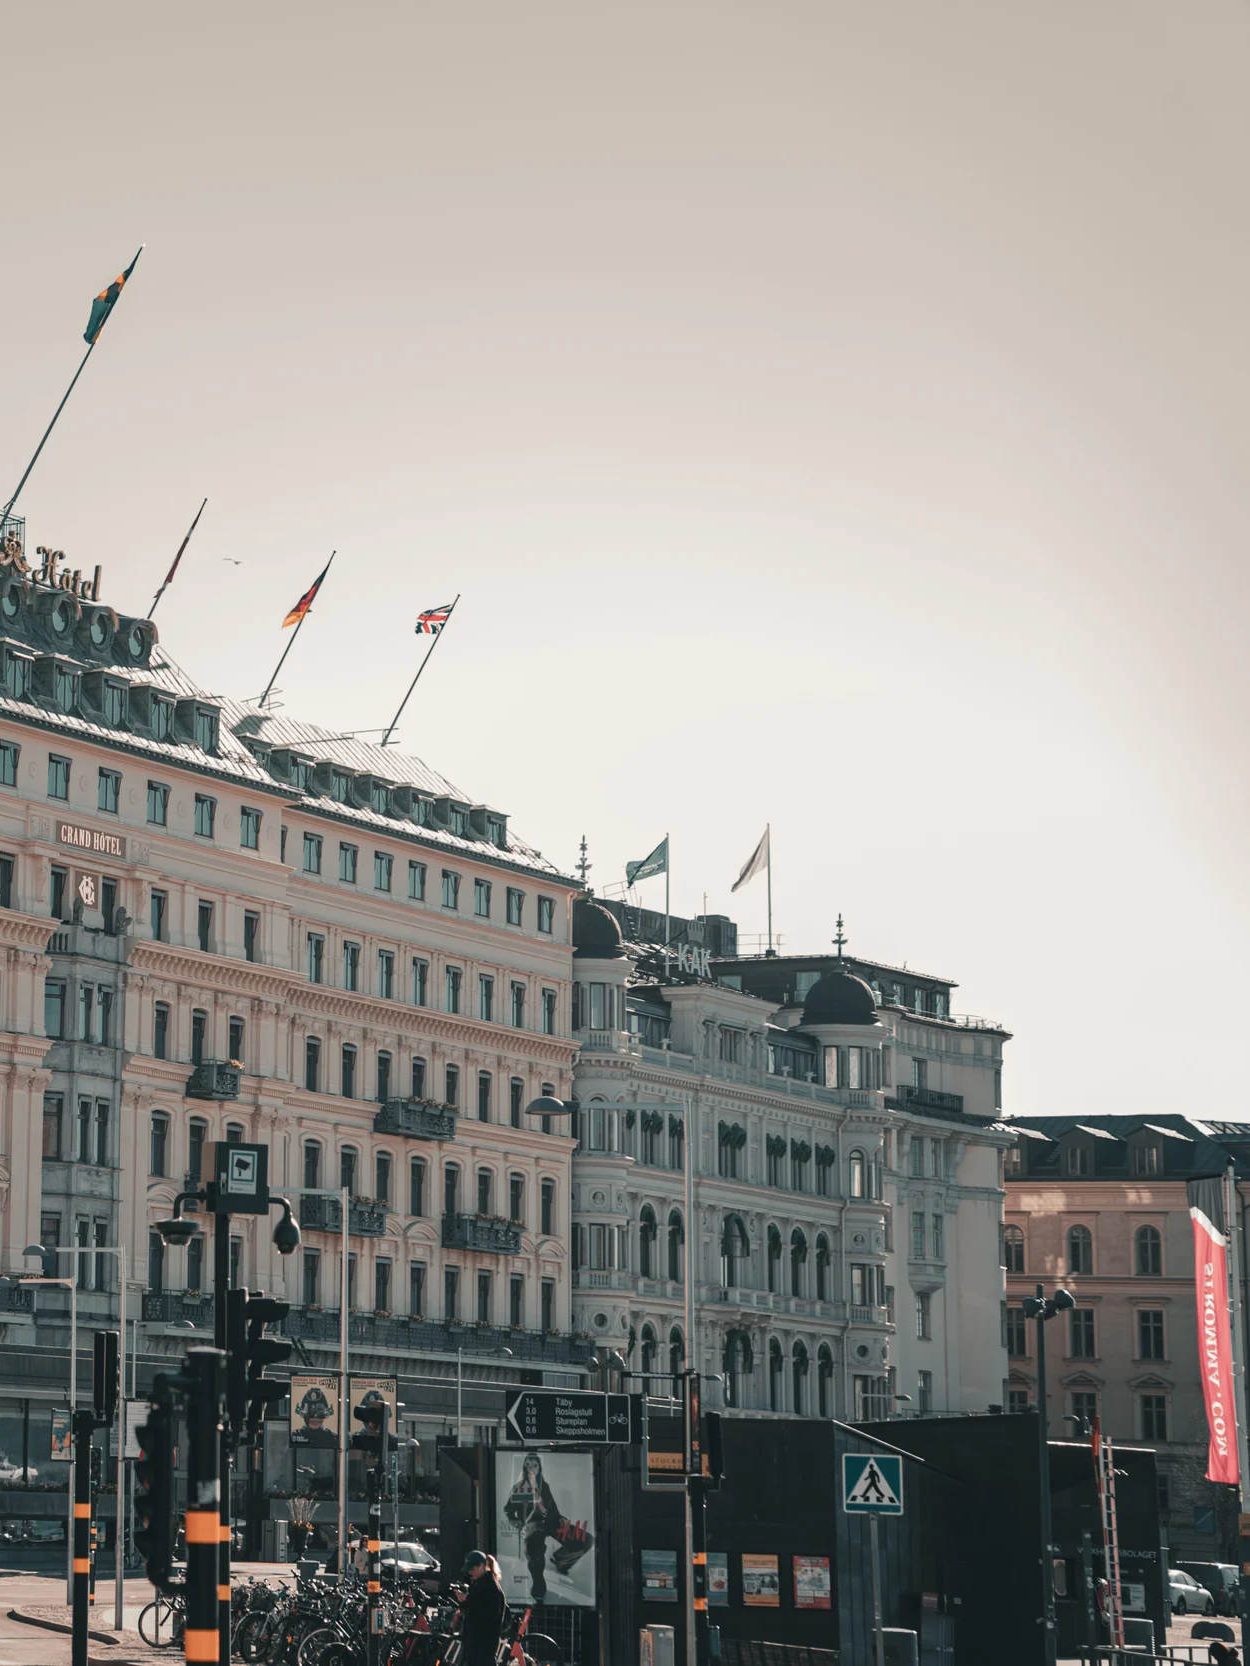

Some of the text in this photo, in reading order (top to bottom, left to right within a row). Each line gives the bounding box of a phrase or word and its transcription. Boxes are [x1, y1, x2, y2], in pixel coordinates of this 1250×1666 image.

[32, 546, 102, 602] Hôtel
[61, 824, 122, 856] GRAND HÔTEL
[678, 942, 712, 979] KAK
[556, 1398, 573, 1407] Täby
[555, 1408, 593, 1417] Roslagstull
[556, 1417, 588, 1426] Stureplan
[556, 1427, 605, 1436] Skeppsholmen
